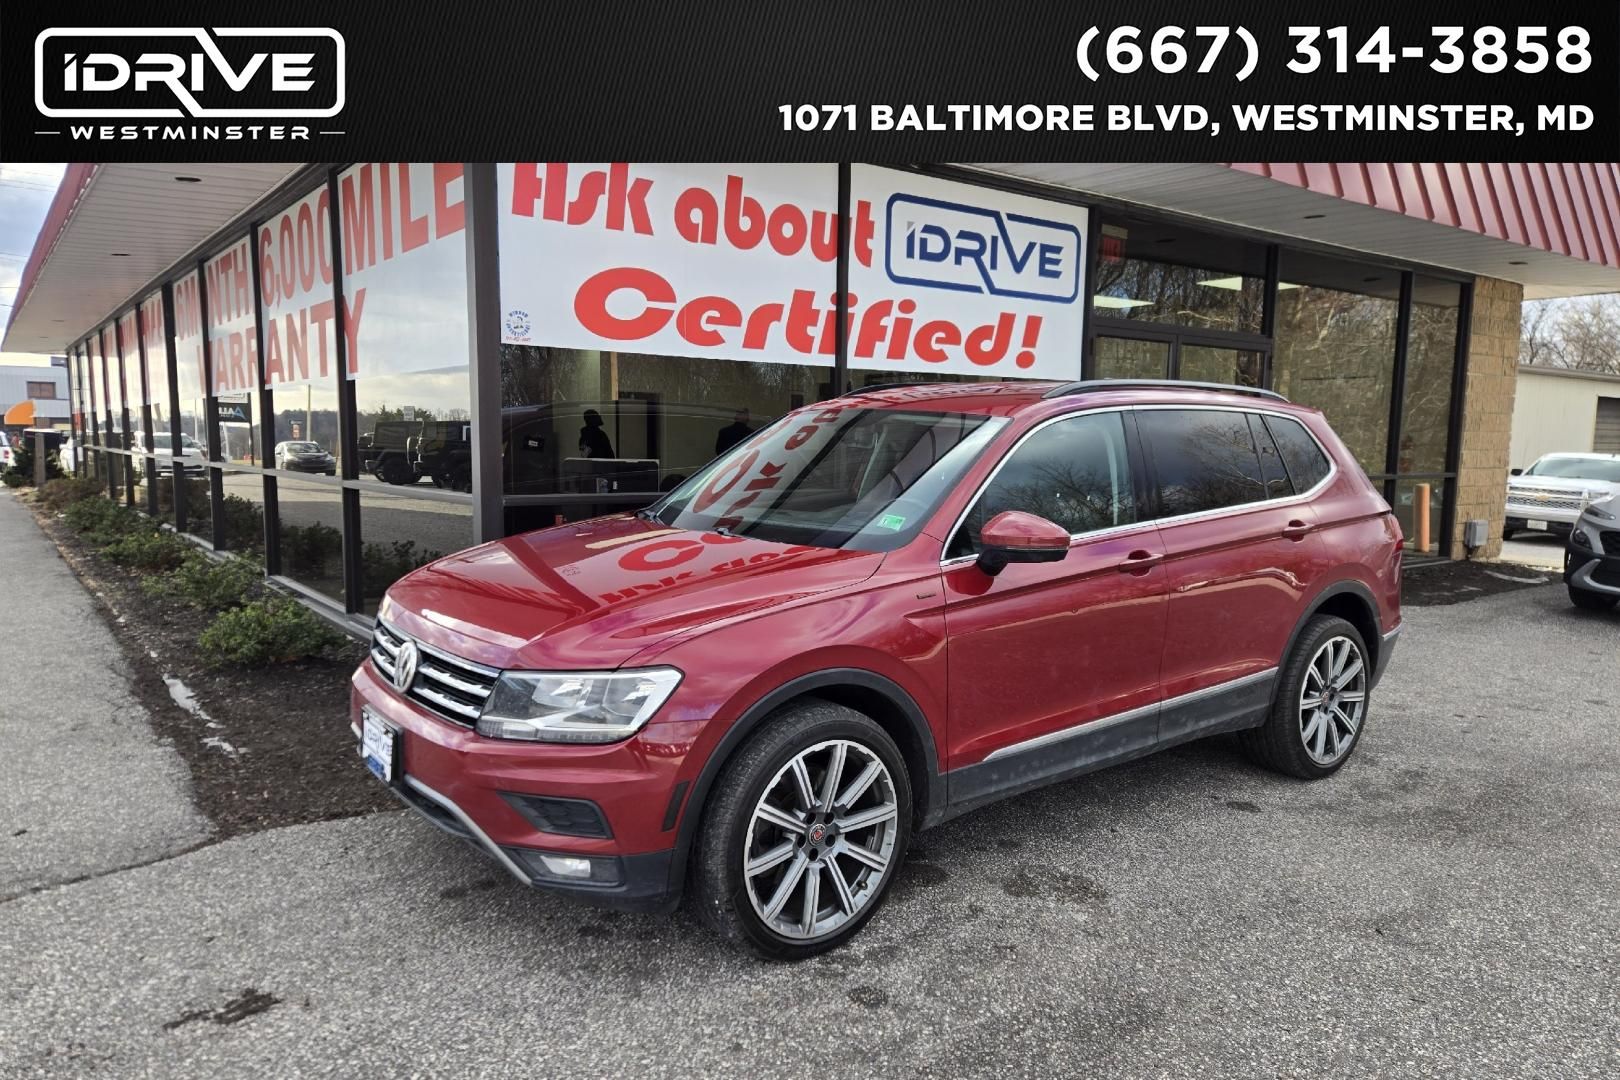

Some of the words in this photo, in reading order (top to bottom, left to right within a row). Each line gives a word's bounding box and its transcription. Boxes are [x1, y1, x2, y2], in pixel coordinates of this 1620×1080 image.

[183, 242, 250, 337] MNTH
[260, 187, 334, 308] 6,000
[341, 162, 466, 277] MILE
[512, 163, 654, 236] Ask
[673, 174, 875, 269] about
[574, 266, 1043, 369] Certified!
